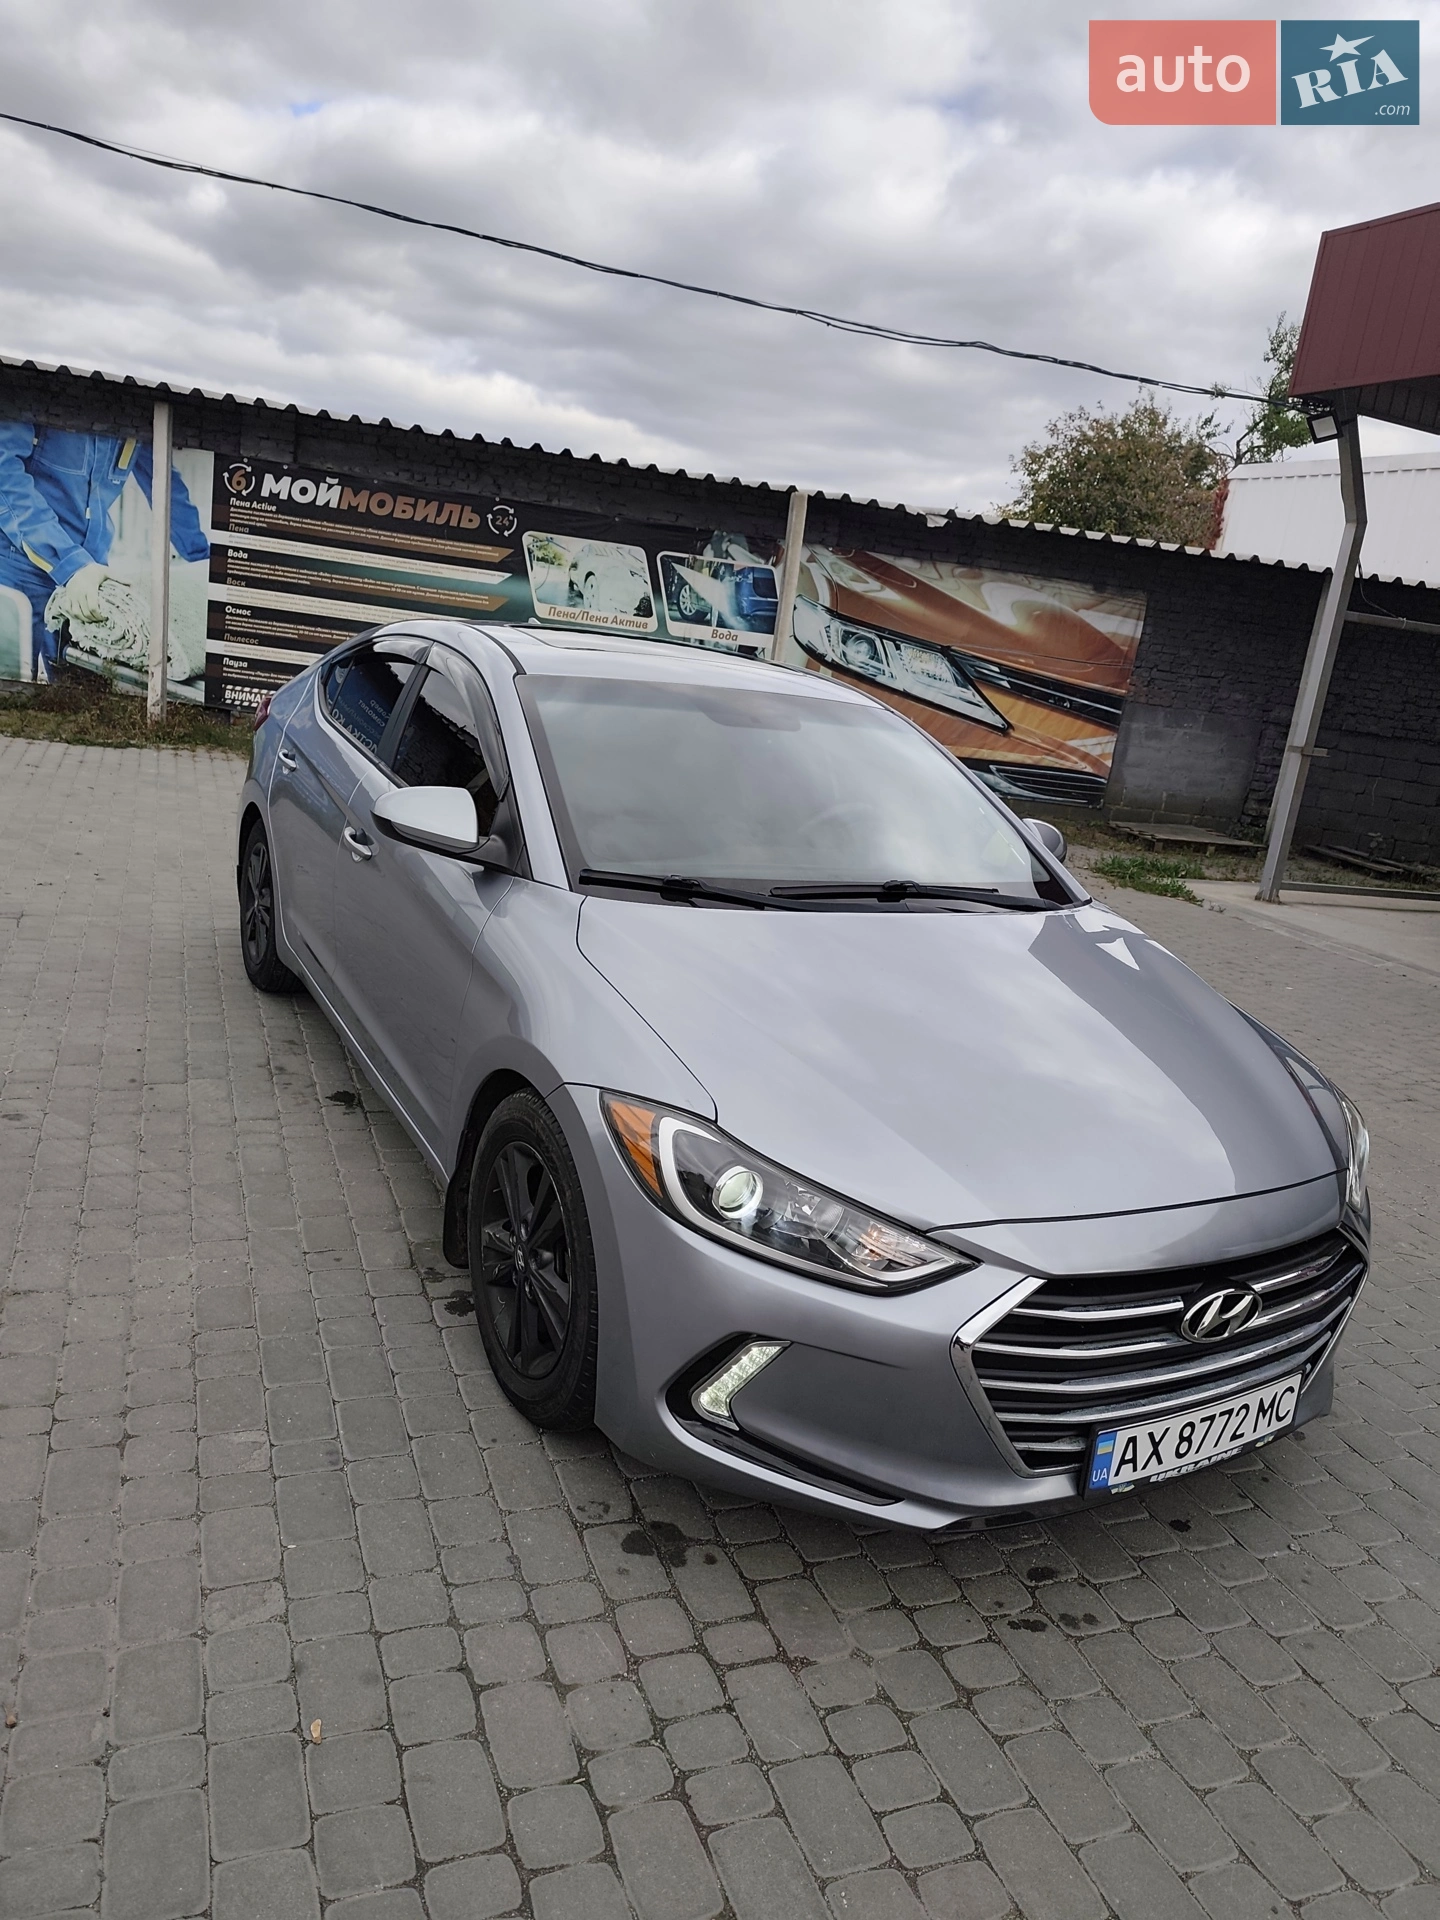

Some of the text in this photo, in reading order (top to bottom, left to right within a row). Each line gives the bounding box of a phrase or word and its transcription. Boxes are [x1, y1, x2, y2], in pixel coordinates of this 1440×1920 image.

[229, 497, 277, 512] Пена Active
[260, 473, 481, 530] МОЙМОБИЛЬ
[228, 522, 249, 533] Пена
[227, 548, 248, 559] Вода
[226, 577, 246, 587] Воск
[225, 605, 252, 616] Осмос
[611, 615, 649, 630] Актив
[224, 633, 259, 645] Пылесос
[711, 629, 739, 642] Вода
[222, 657, 248, 668] Пауза
[1113, 1385, 1296, 1478] AX 8772 MC
[1092, 1468, 1108, 1482] UA
